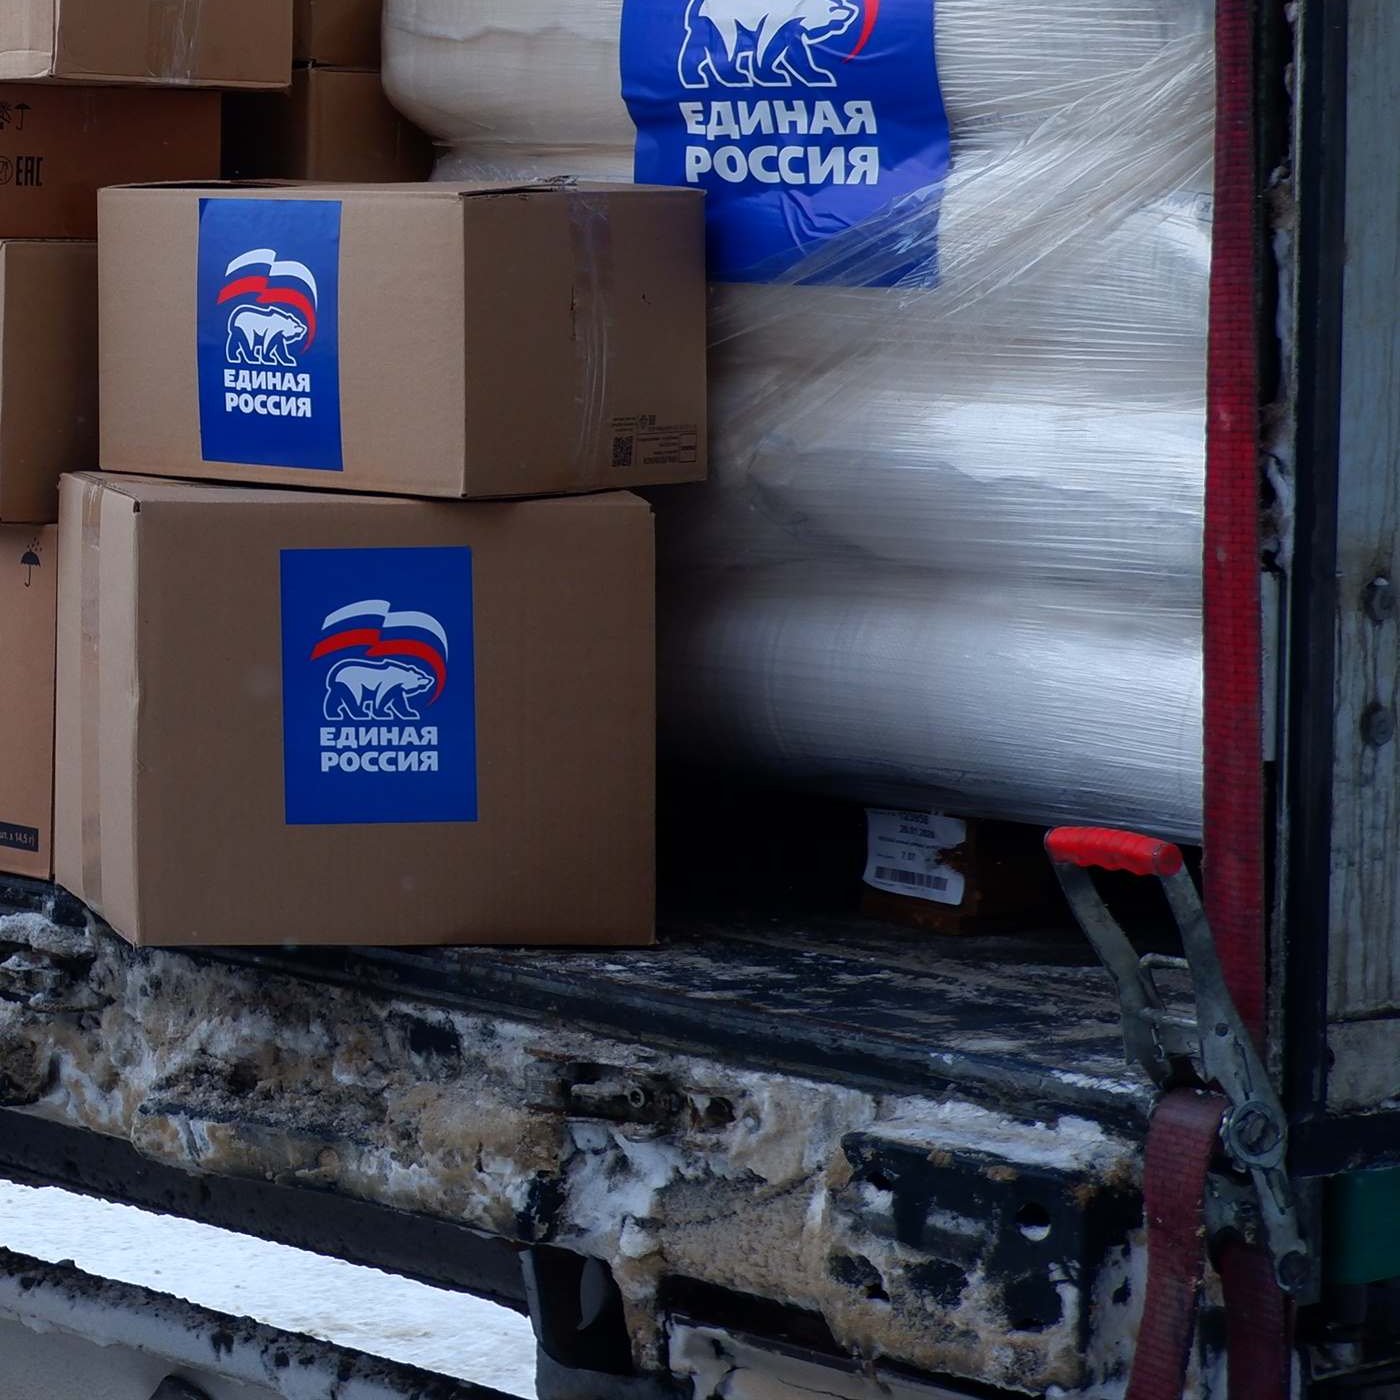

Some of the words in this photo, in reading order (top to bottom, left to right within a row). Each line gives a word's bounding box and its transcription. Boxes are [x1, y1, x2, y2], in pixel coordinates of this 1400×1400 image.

[679, 99, 878, 140] ЕДИНАЯ
[685, 145, 880, 185] РОССИЯ
[223, 369, 311, 394] ЕДИНАЯ
[224, 391, 312, 418] РОССИЯ
[319, 726, 438, 750] ЕДИНАЯ
[319, 751, 439, 773] РОССИЯ
